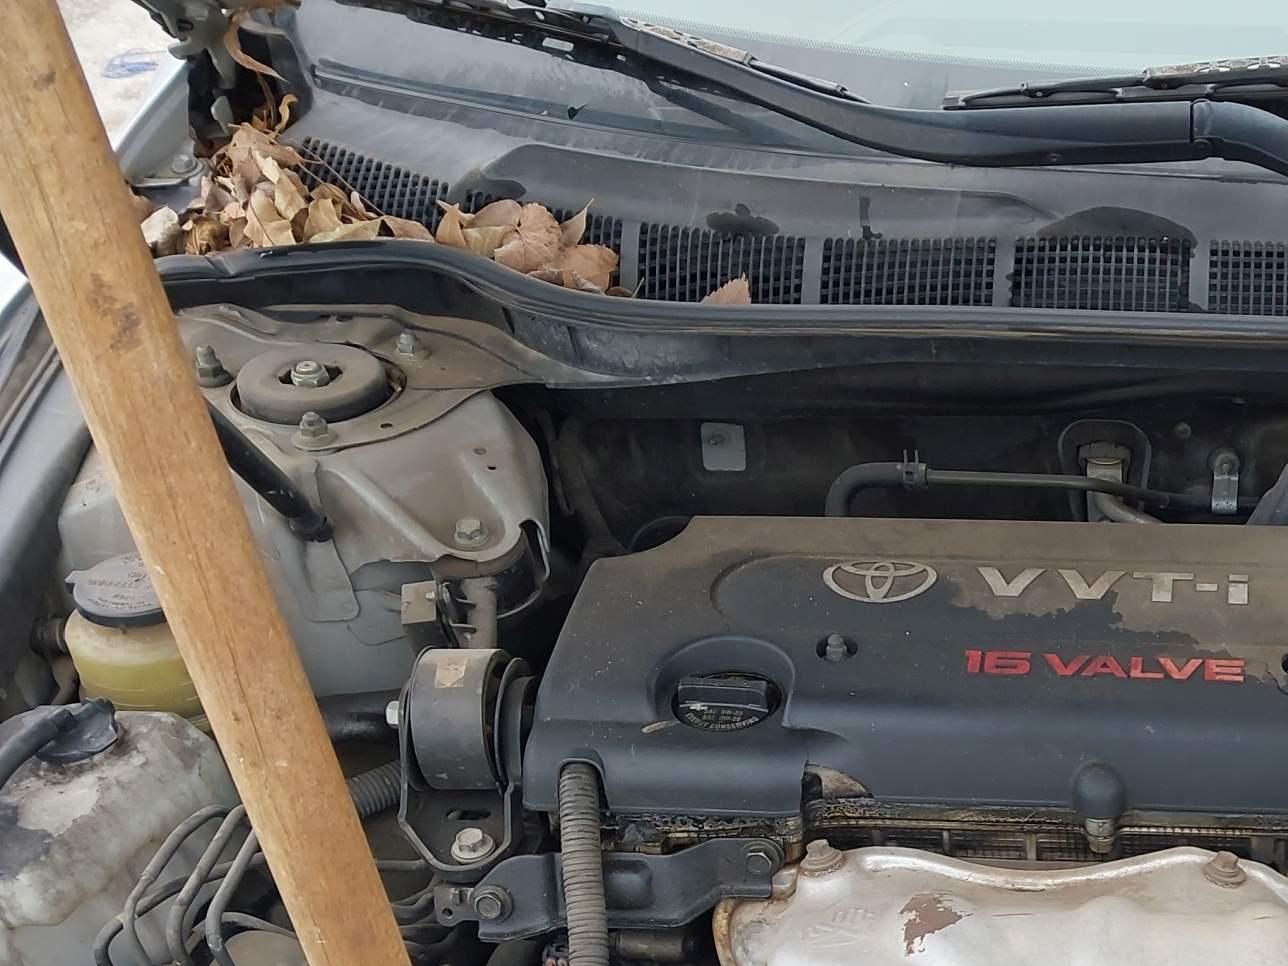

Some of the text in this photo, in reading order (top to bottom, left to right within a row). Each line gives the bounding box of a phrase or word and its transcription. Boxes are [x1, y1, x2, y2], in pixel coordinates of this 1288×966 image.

[977, 567, 1249, 604] VVT-i
[965, 649, 1245, 682] 16 VALVE
